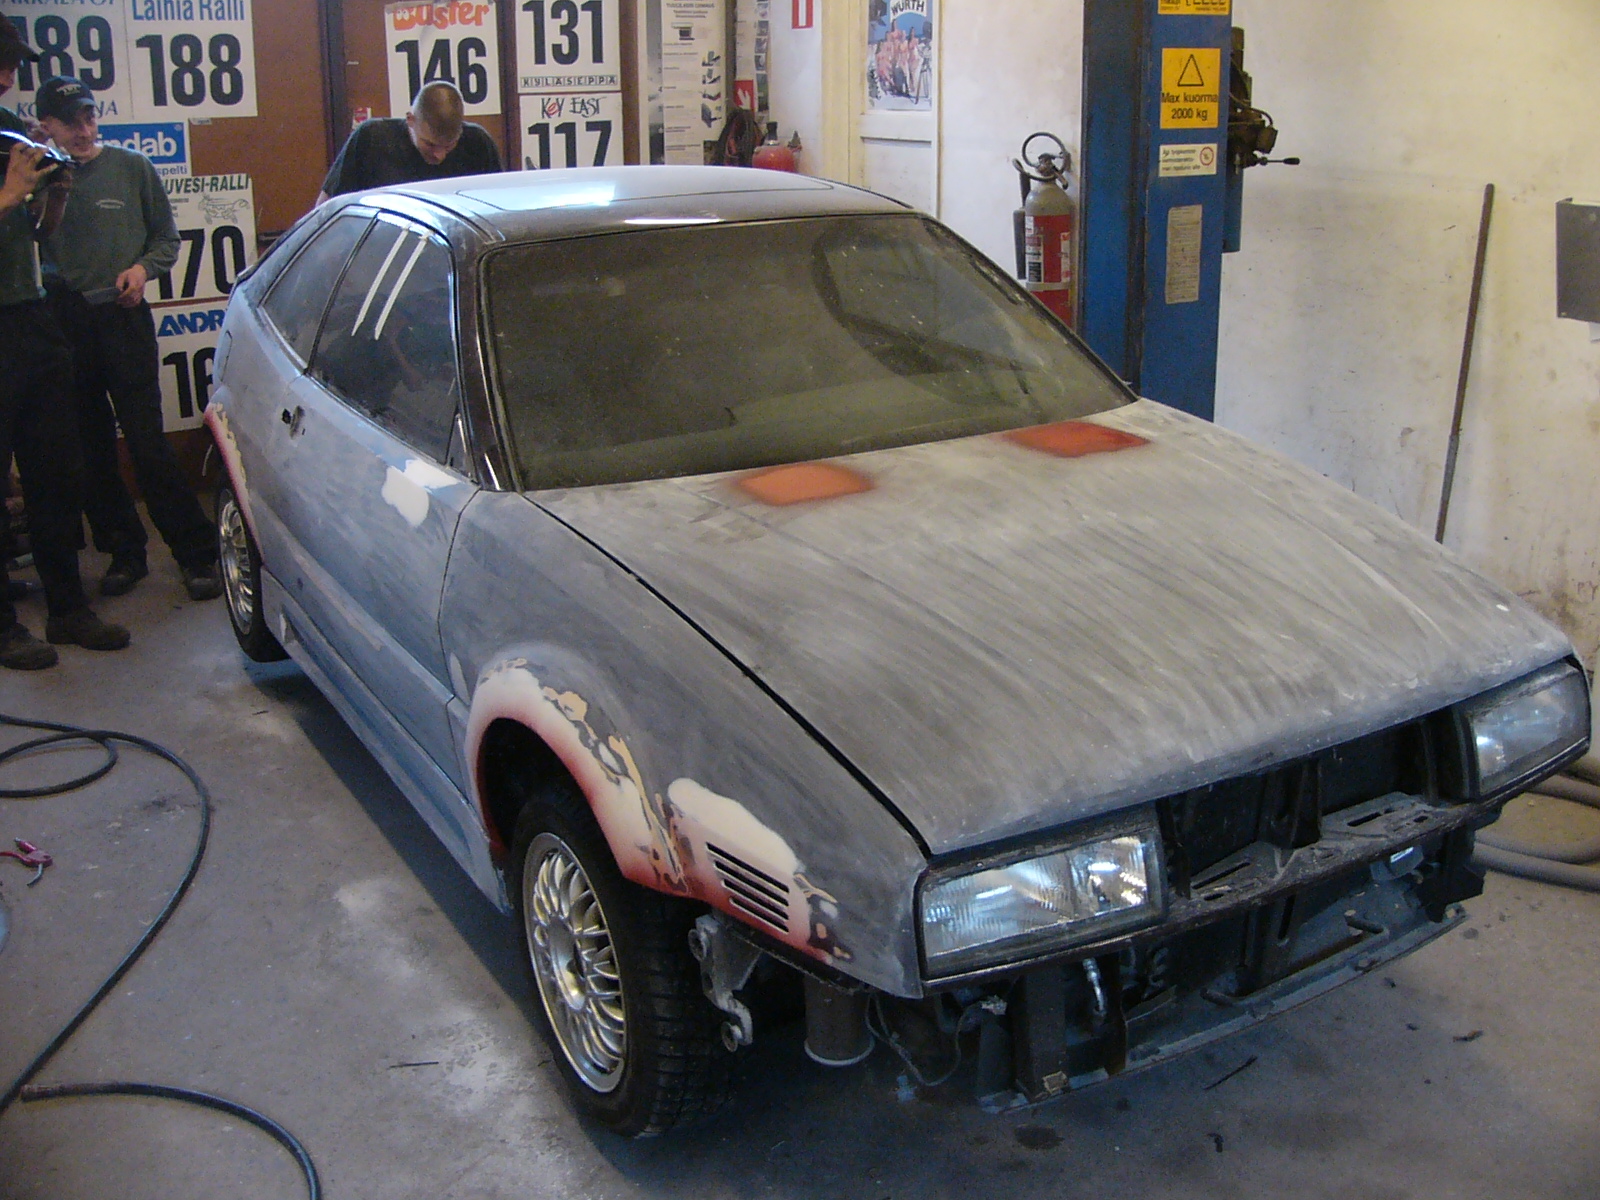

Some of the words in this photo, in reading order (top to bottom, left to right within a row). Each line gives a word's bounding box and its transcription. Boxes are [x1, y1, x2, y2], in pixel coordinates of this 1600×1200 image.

[522, 0, 604, 65] 131
[136, 33, 244, 107] 188
[395, 37, 488, 105] 146
[1161, 93, 1180, 103] Max
[1184, 93, 1218, 103] kuorma
[1172, 108, 1194, 119] 2000
[1196, 108, 1208, 121] kg
[528, 120, 612, 170] 117
[158, 308, 227, 337] ANDR
